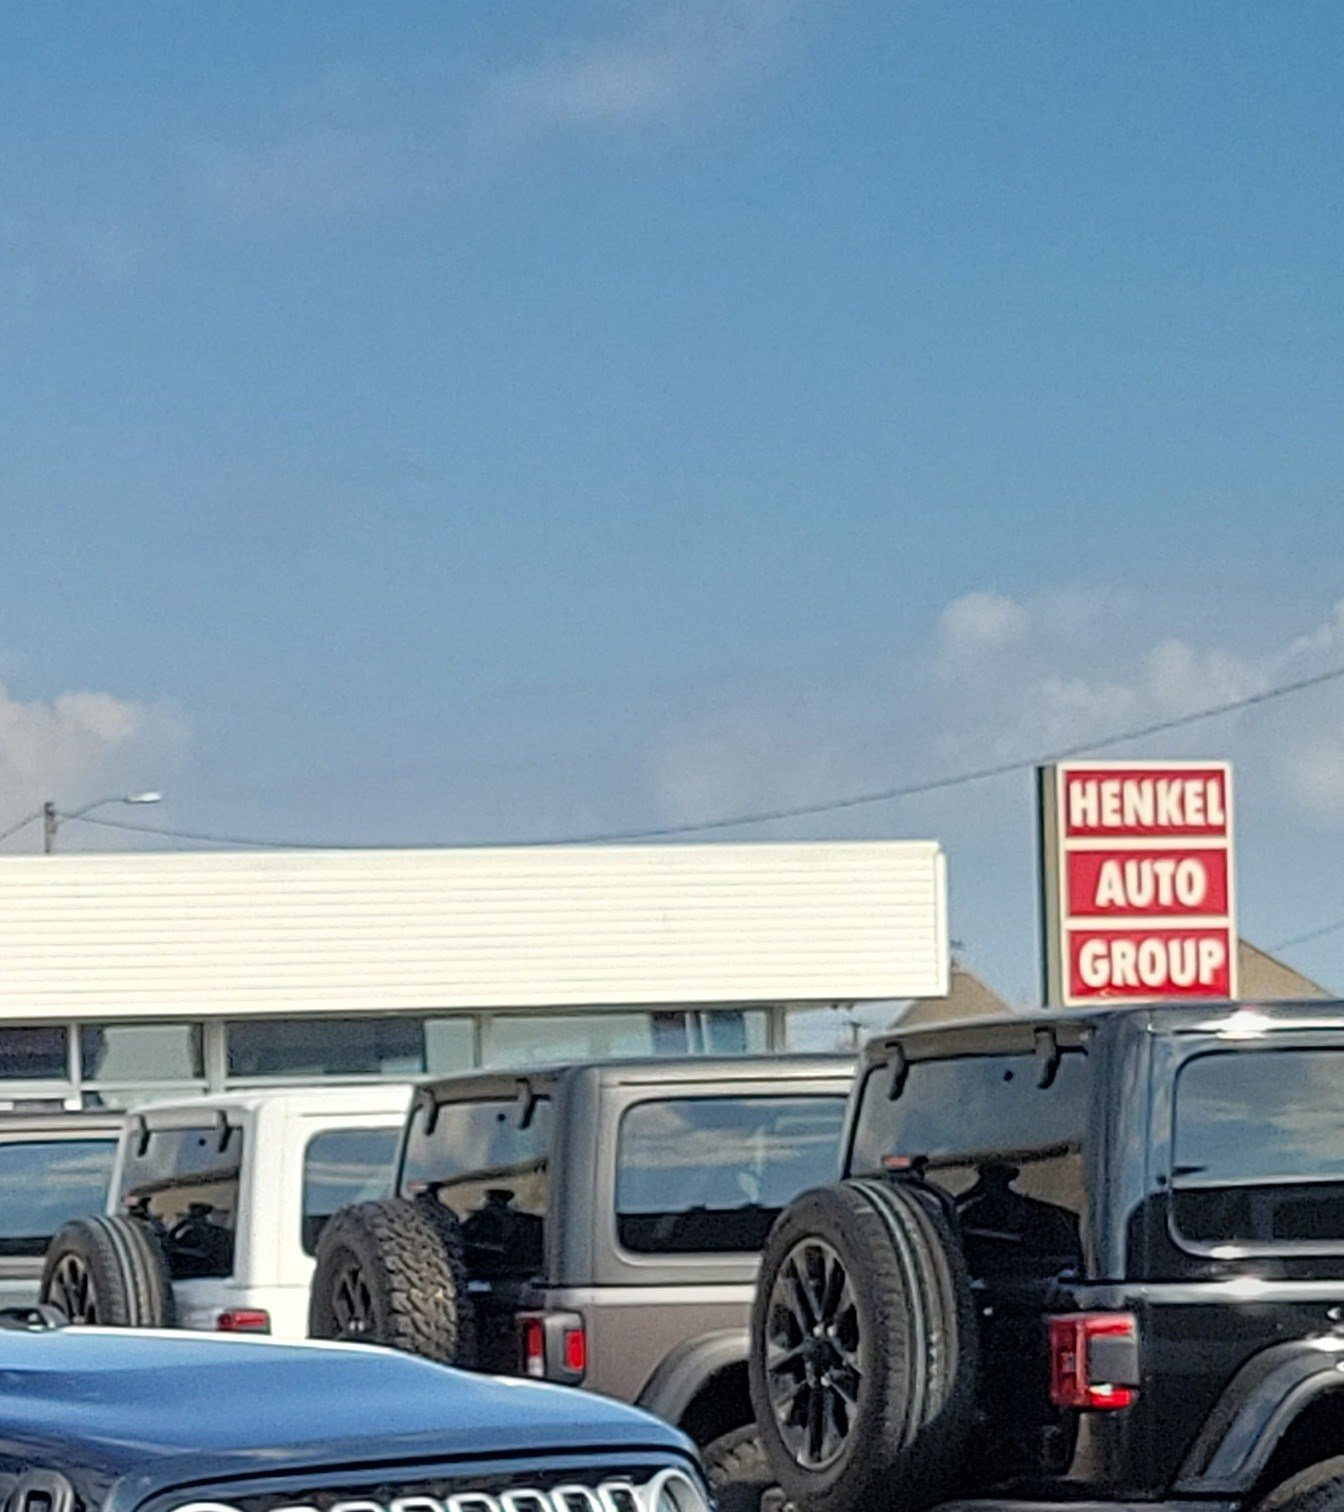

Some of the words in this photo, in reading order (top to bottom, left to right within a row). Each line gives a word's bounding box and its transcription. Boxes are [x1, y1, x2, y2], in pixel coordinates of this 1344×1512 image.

[1069, 778, 1225, 828] HENKEL
[1095, 858, 1208, 908] AUTO
[1079, 936, 1226, 988] GROUP
